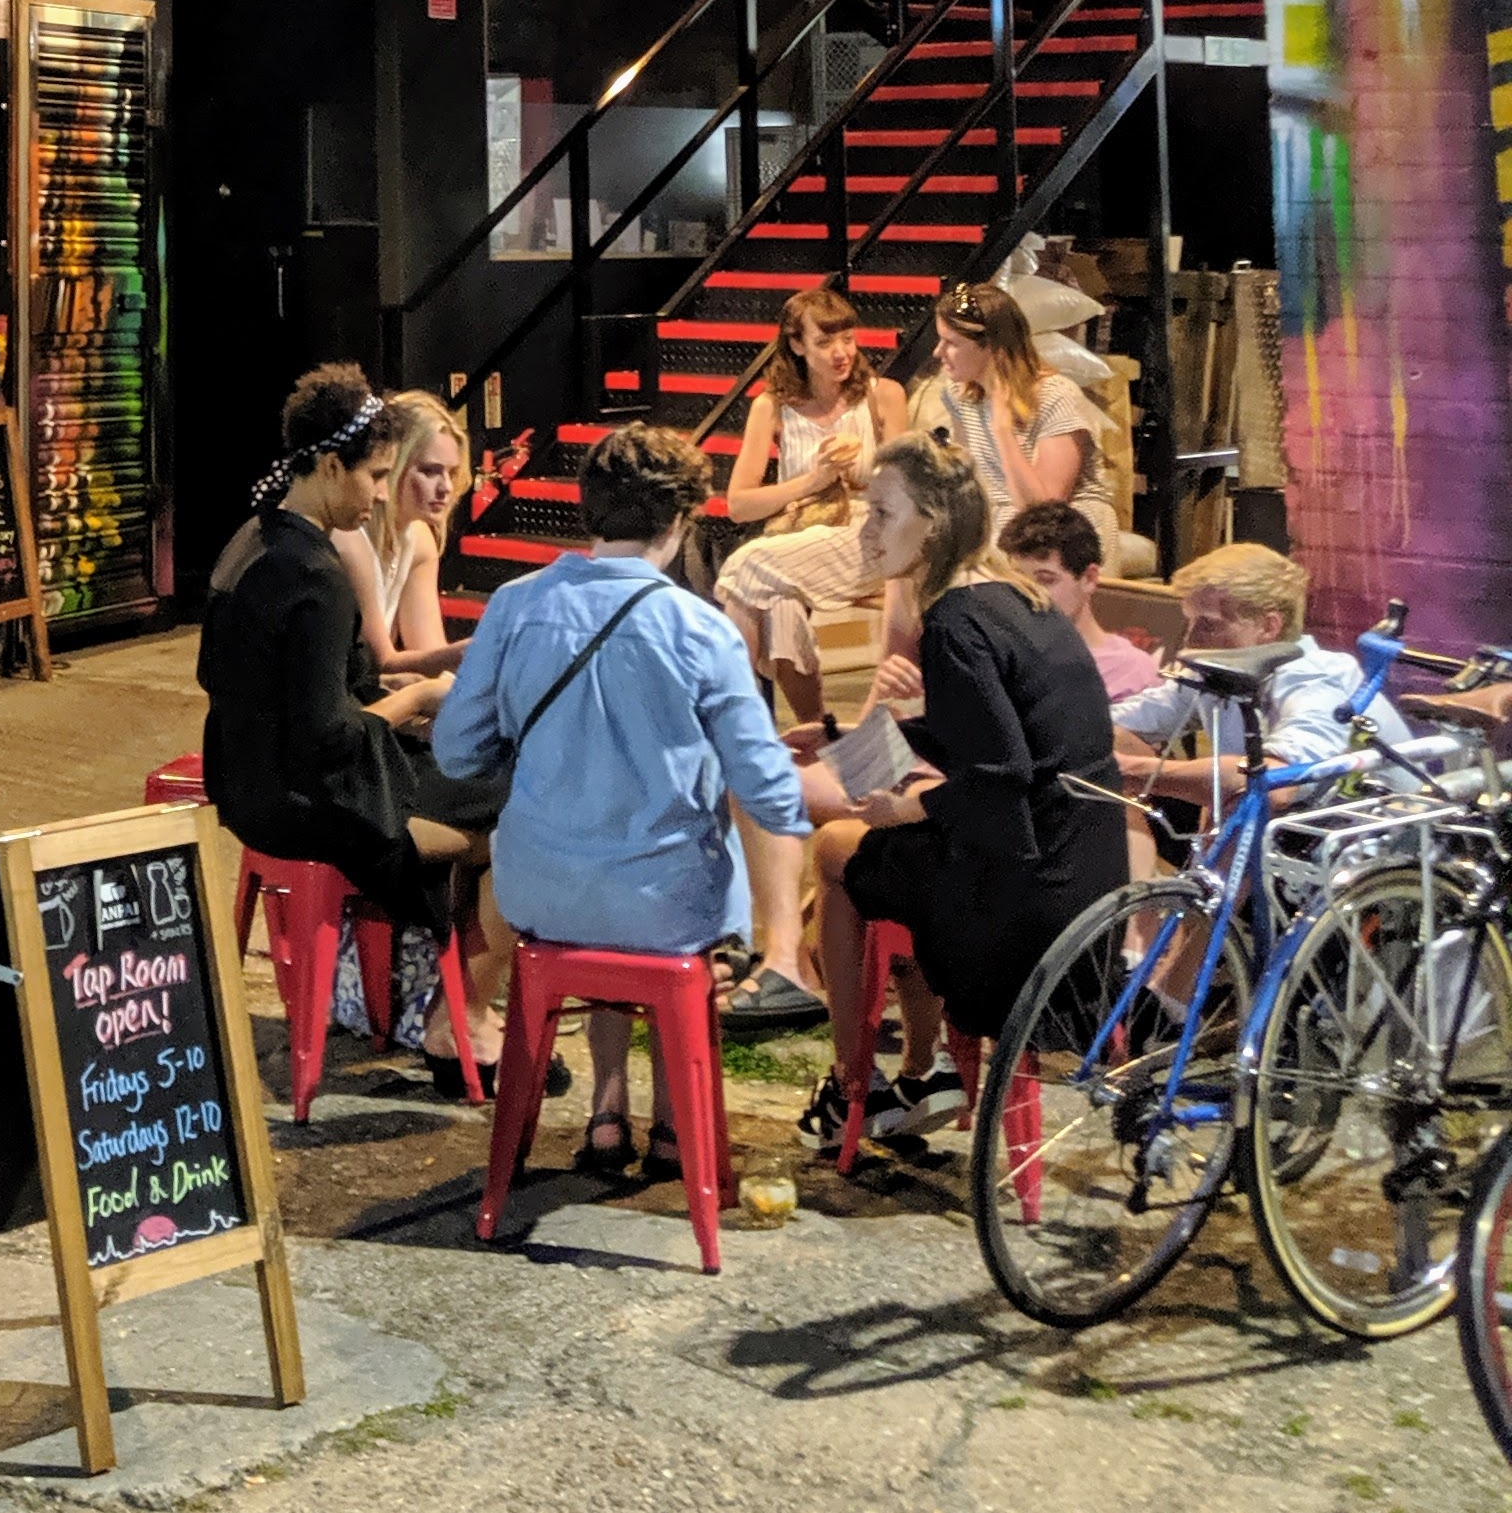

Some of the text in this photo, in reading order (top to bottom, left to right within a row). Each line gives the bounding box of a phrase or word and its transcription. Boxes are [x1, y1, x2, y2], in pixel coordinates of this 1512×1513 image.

[63, 950, 188, 1006] Tap Room
[95, 990, 173, 1047] open!
[81, 1046, 205, 1113] Fridays 5-10
[78, 1101, 222, 1170] Saturdays 12-10
[87, 1155, 229, 1228] Food & Drink
